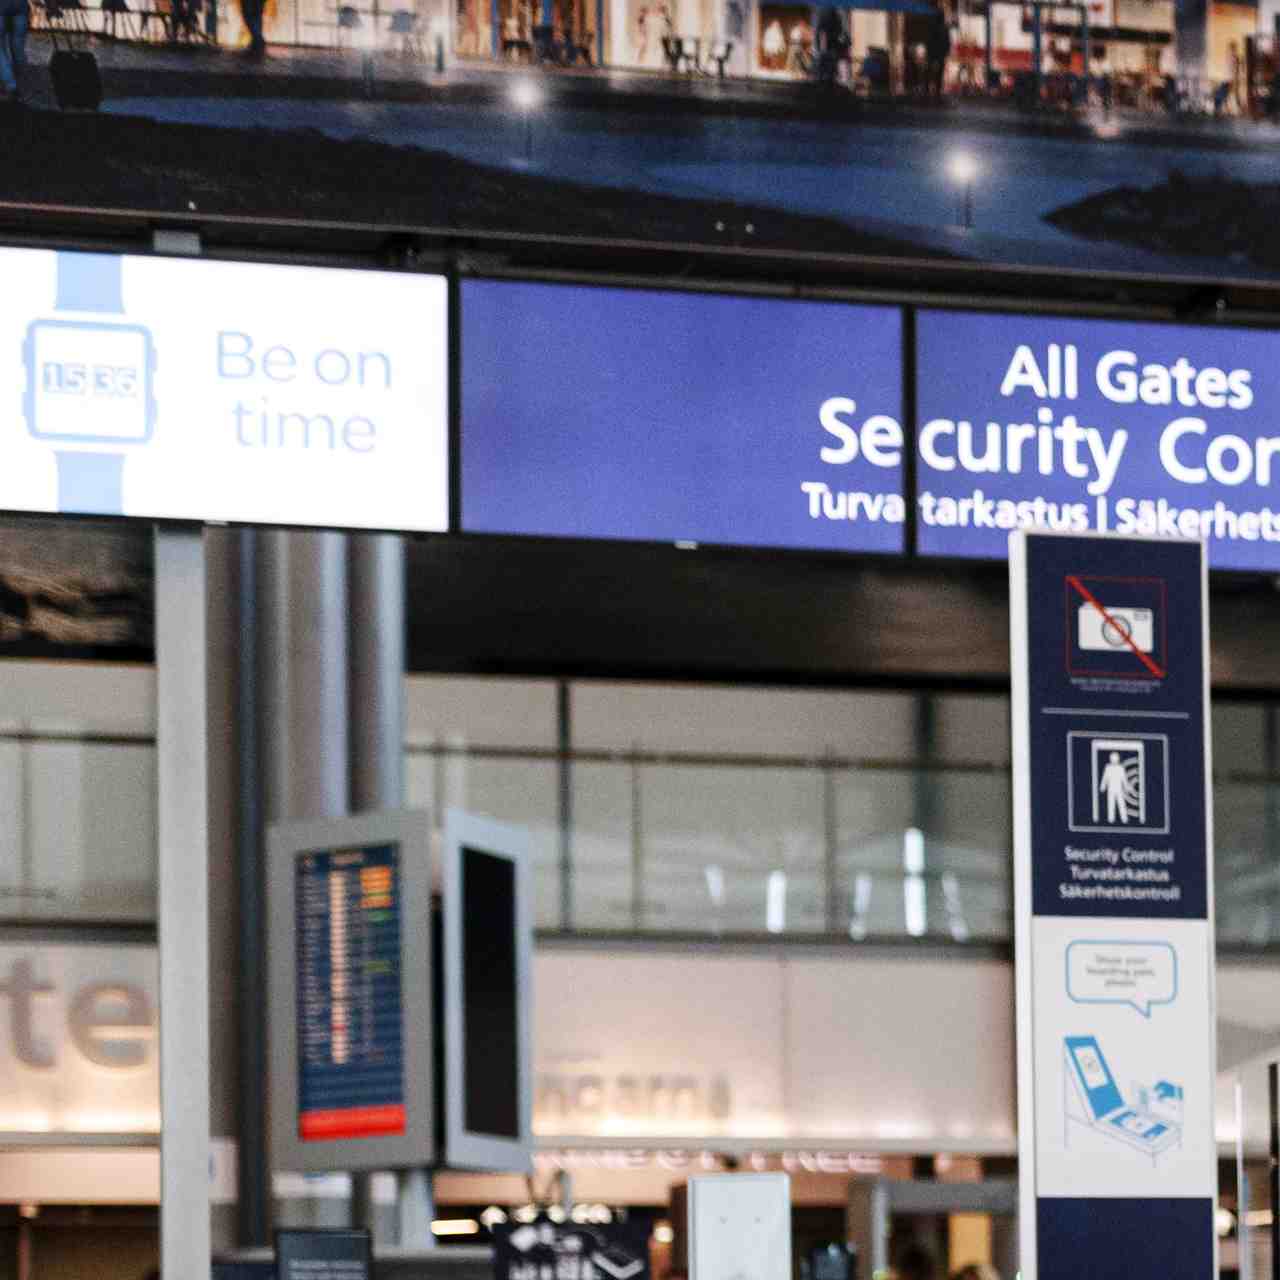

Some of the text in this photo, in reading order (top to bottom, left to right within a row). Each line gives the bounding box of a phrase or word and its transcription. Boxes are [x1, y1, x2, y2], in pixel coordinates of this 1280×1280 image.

[214, 330, 393, 389] Be on
[1000, 343, 1255, 410] All Gates
[231, 398, 378, 455] time
[817, 396, 1129, 496] Security
[1064, 845, 1174, 865] Security Control
